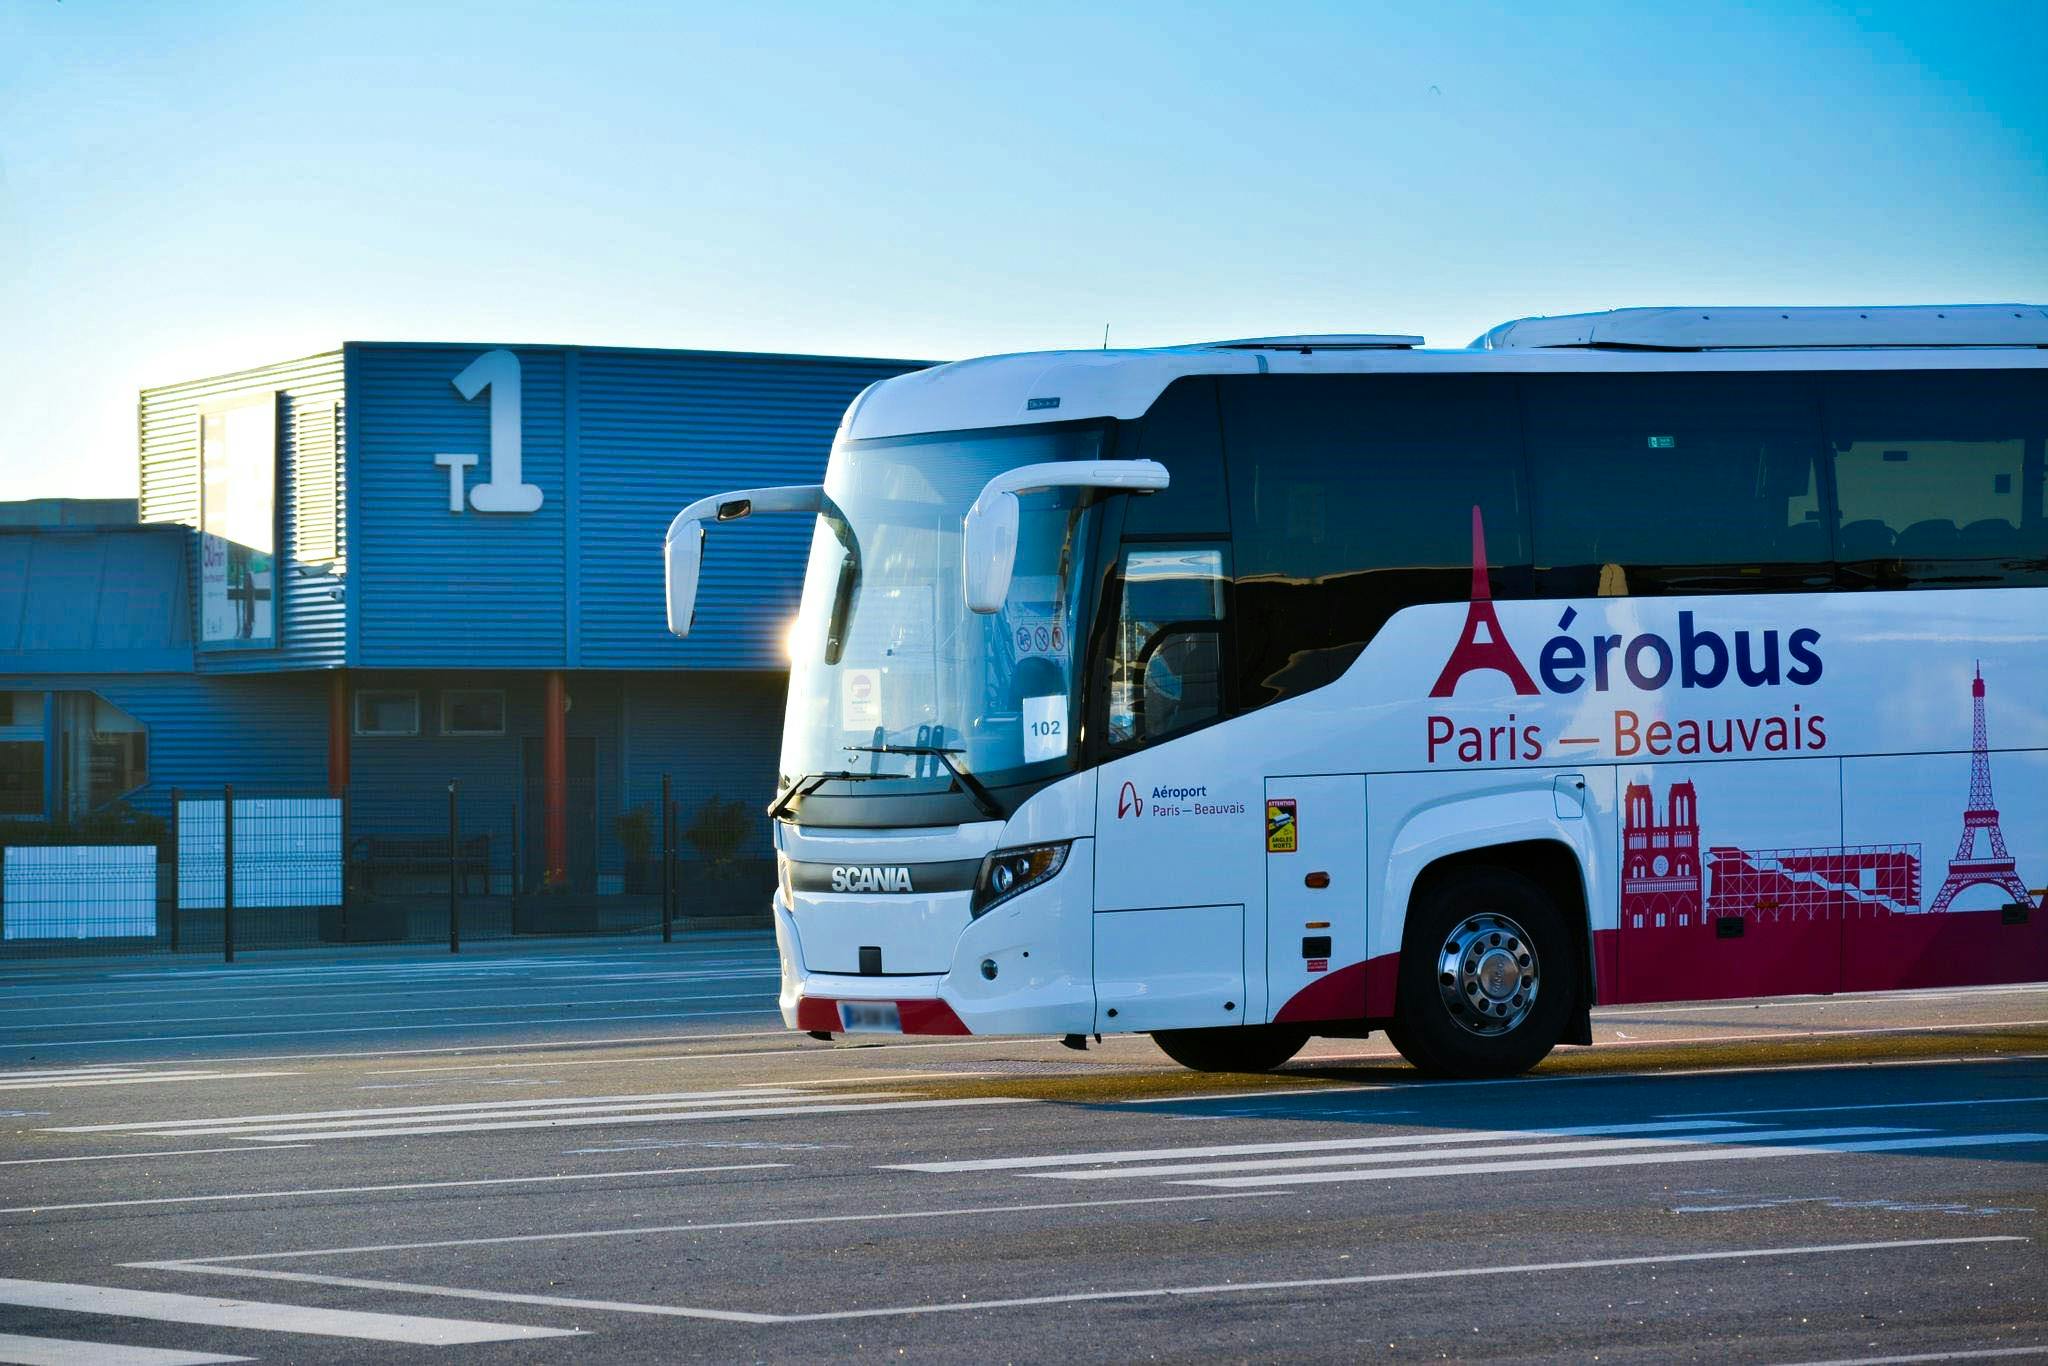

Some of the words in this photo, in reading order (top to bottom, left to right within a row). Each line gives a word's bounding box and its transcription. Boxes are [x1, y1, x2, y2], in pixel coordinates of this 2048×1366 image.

[1031, 720, 1061, 737] 102
[1427, 713, 1543, 763] Paris
[1614, 703, 1827, 757] Beauvais
[1151, 785, 1207, 801] Aéroport
[1152, 804, 1180, 817] Paris
[1194, 801, 1246, 815] Beauvais
[831, 866, 913, 892] SCANIA
